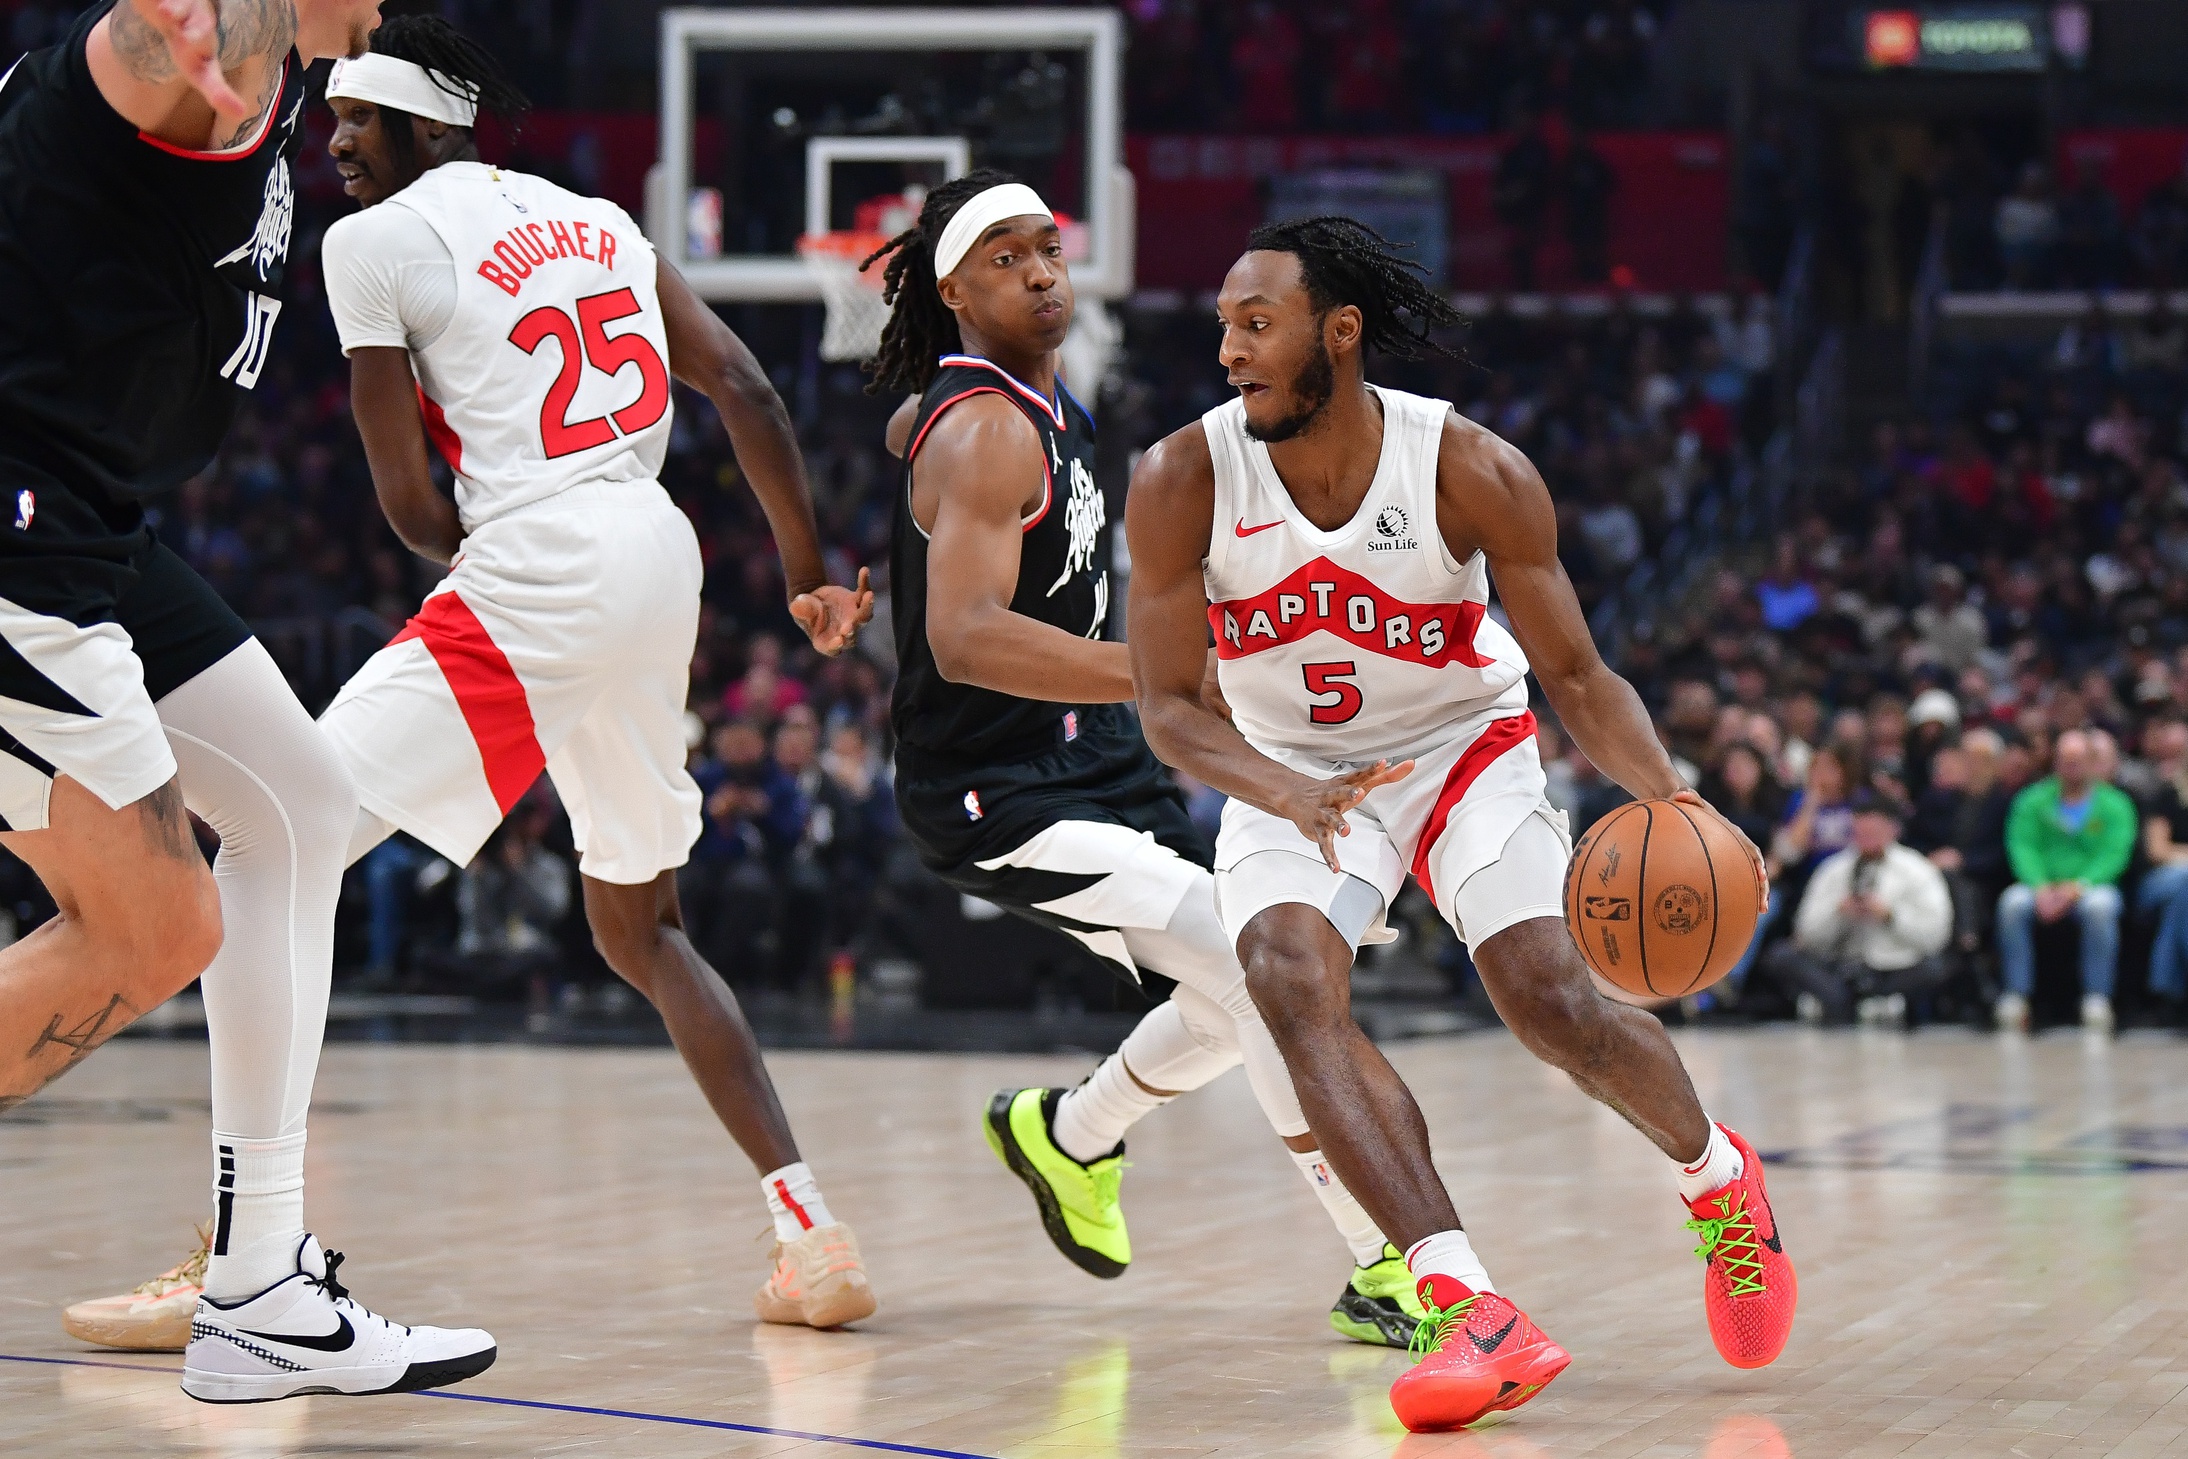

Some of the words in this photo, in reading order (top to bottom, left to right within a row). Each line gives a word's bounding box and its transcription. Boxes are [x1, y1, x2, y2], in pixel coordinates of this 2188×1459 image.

[477, 220, 616, 297] BOUCHER
[220, 290, 282, 389] 10
[507, 286, 669, 461] 25
[1367, 540, 1392, 551] Sun
[1395, 538, 1418, 550] Life
[1224, 581, 1445, 658] RAPTORS
[1301, 660, 1364, 725] 5
